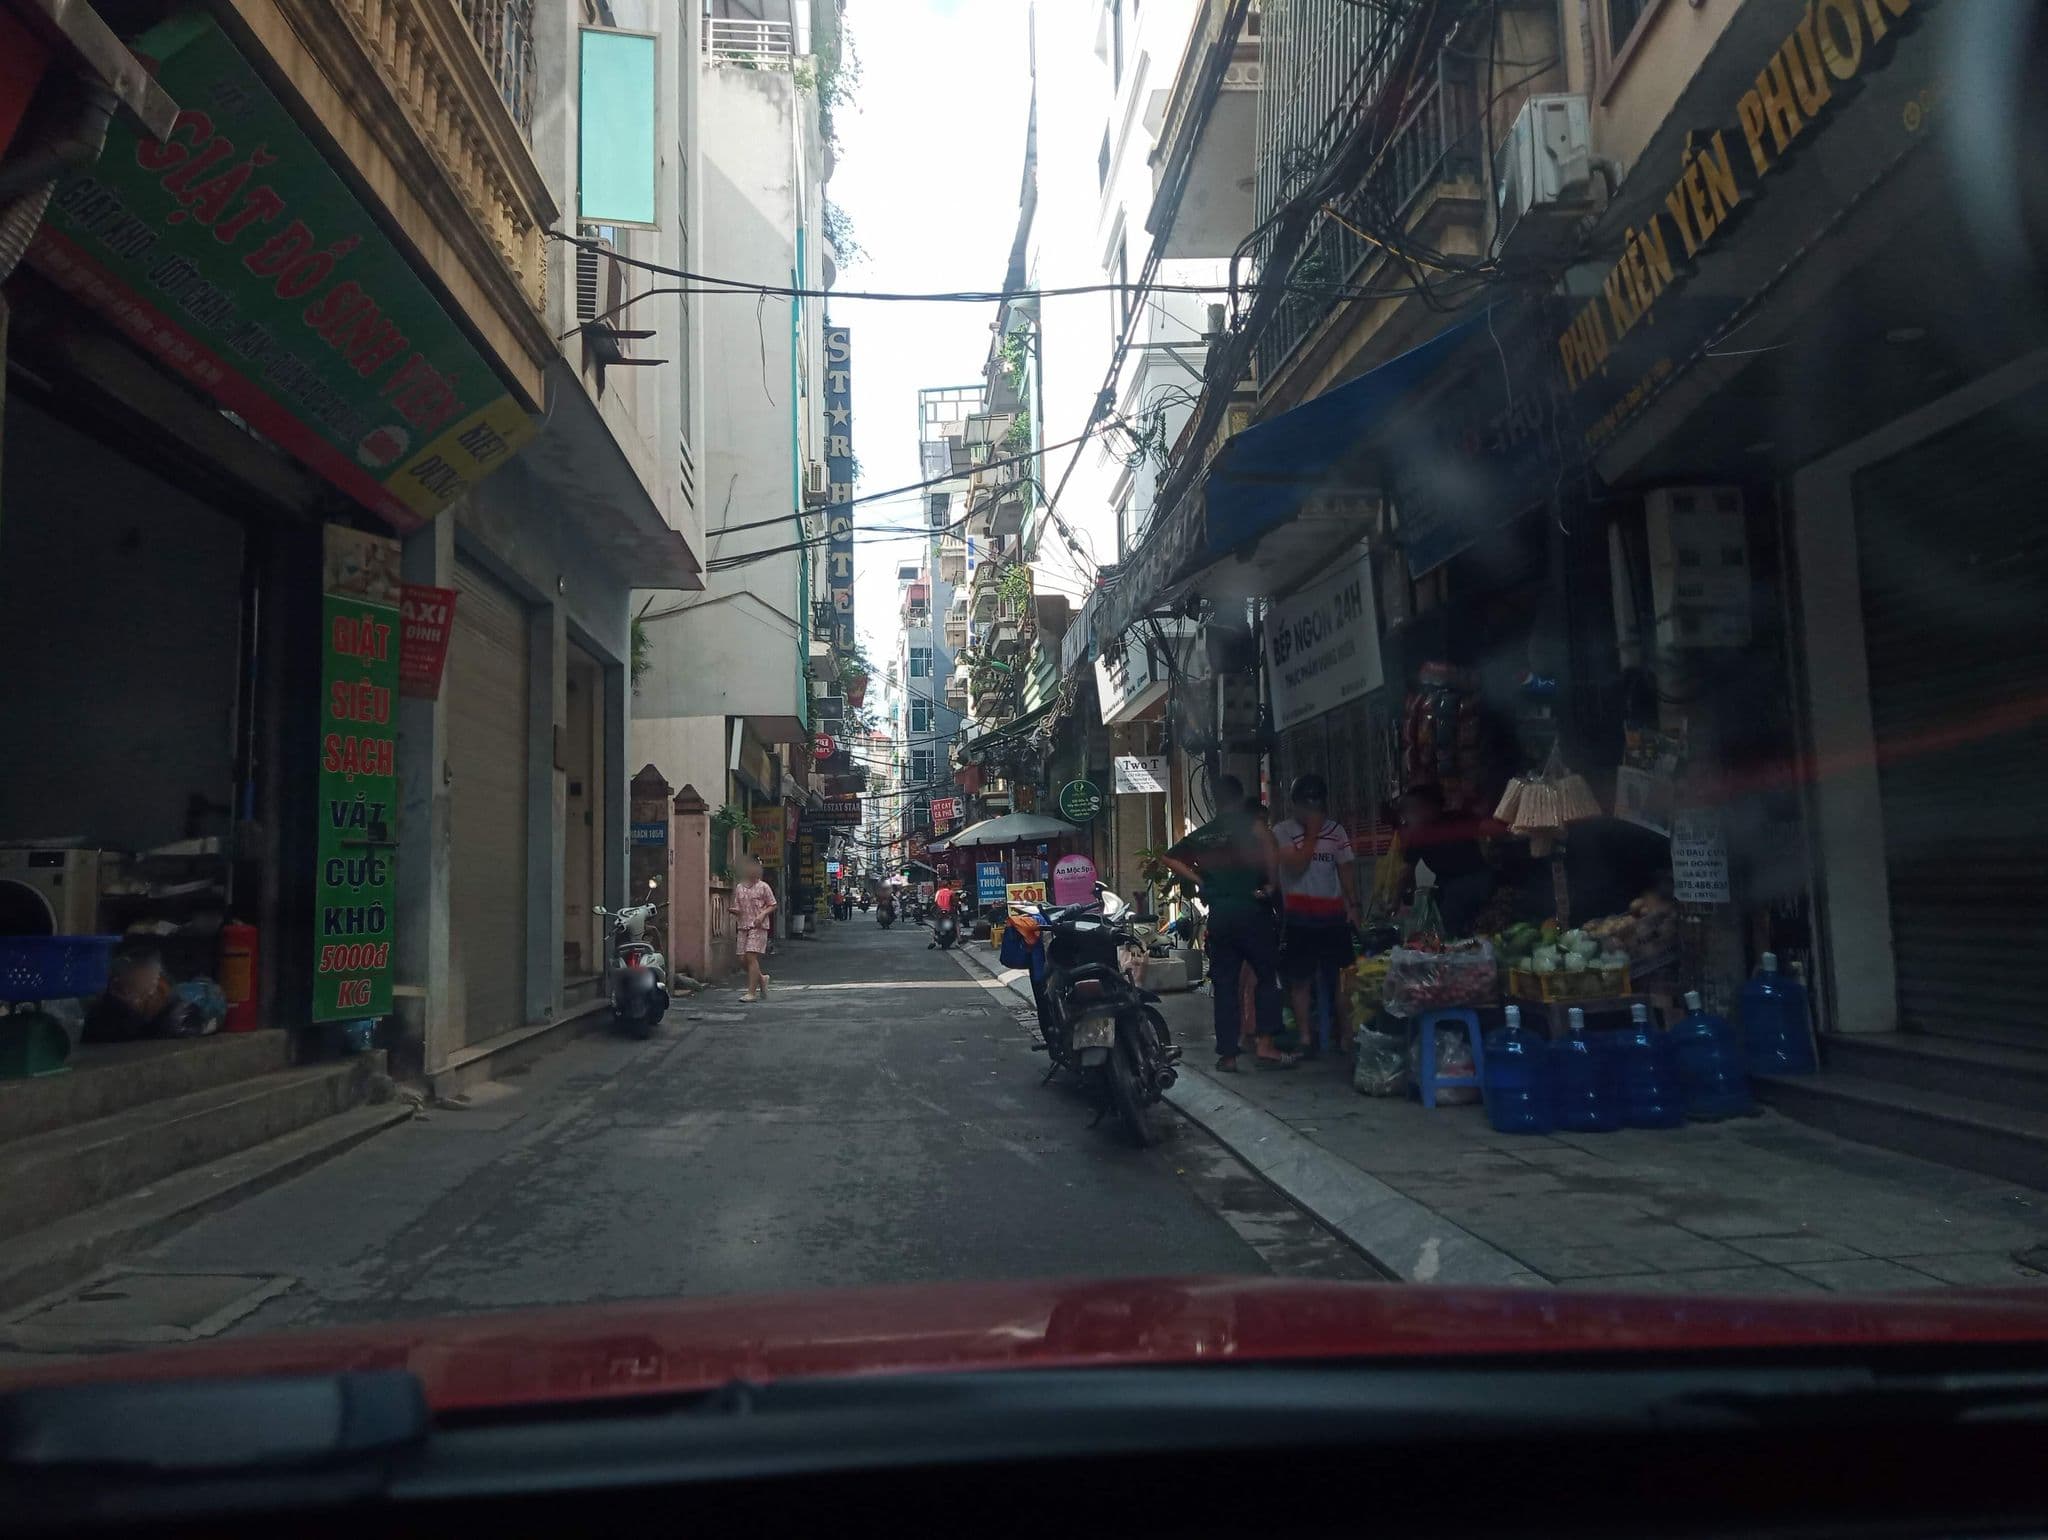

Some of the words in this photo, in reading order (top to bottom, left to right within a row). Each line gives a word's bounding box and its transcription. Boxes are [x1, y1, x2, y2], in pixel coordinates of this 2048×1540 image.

[1558, 296, 1609, 392] PHỤ
[1602, 223, 1675, 342] KIỆN
[1665, 130, 1741, 259] YẾN
[304, 280, 409, 378] SINH
[332, 613, 391, 667] GIẶT
[331, 677, 391, 725] SIÊU
[323, 733, 394, 782] SẠCH
[1123, 760, 1147, 770] Two
[1151, 759, 1159, 769] T
[329, 791, 386, 829] VẮT
[325, 857, 386, 894] CỰC
[980, 876, 1006, 888] THUỐC
[1067, 867, 1080, 875] Mộc
[1010, 885, 1043, 902] XÔI
[322, 900, 386, 937] KHÔ
[336, 978, 372, 1009] KG
